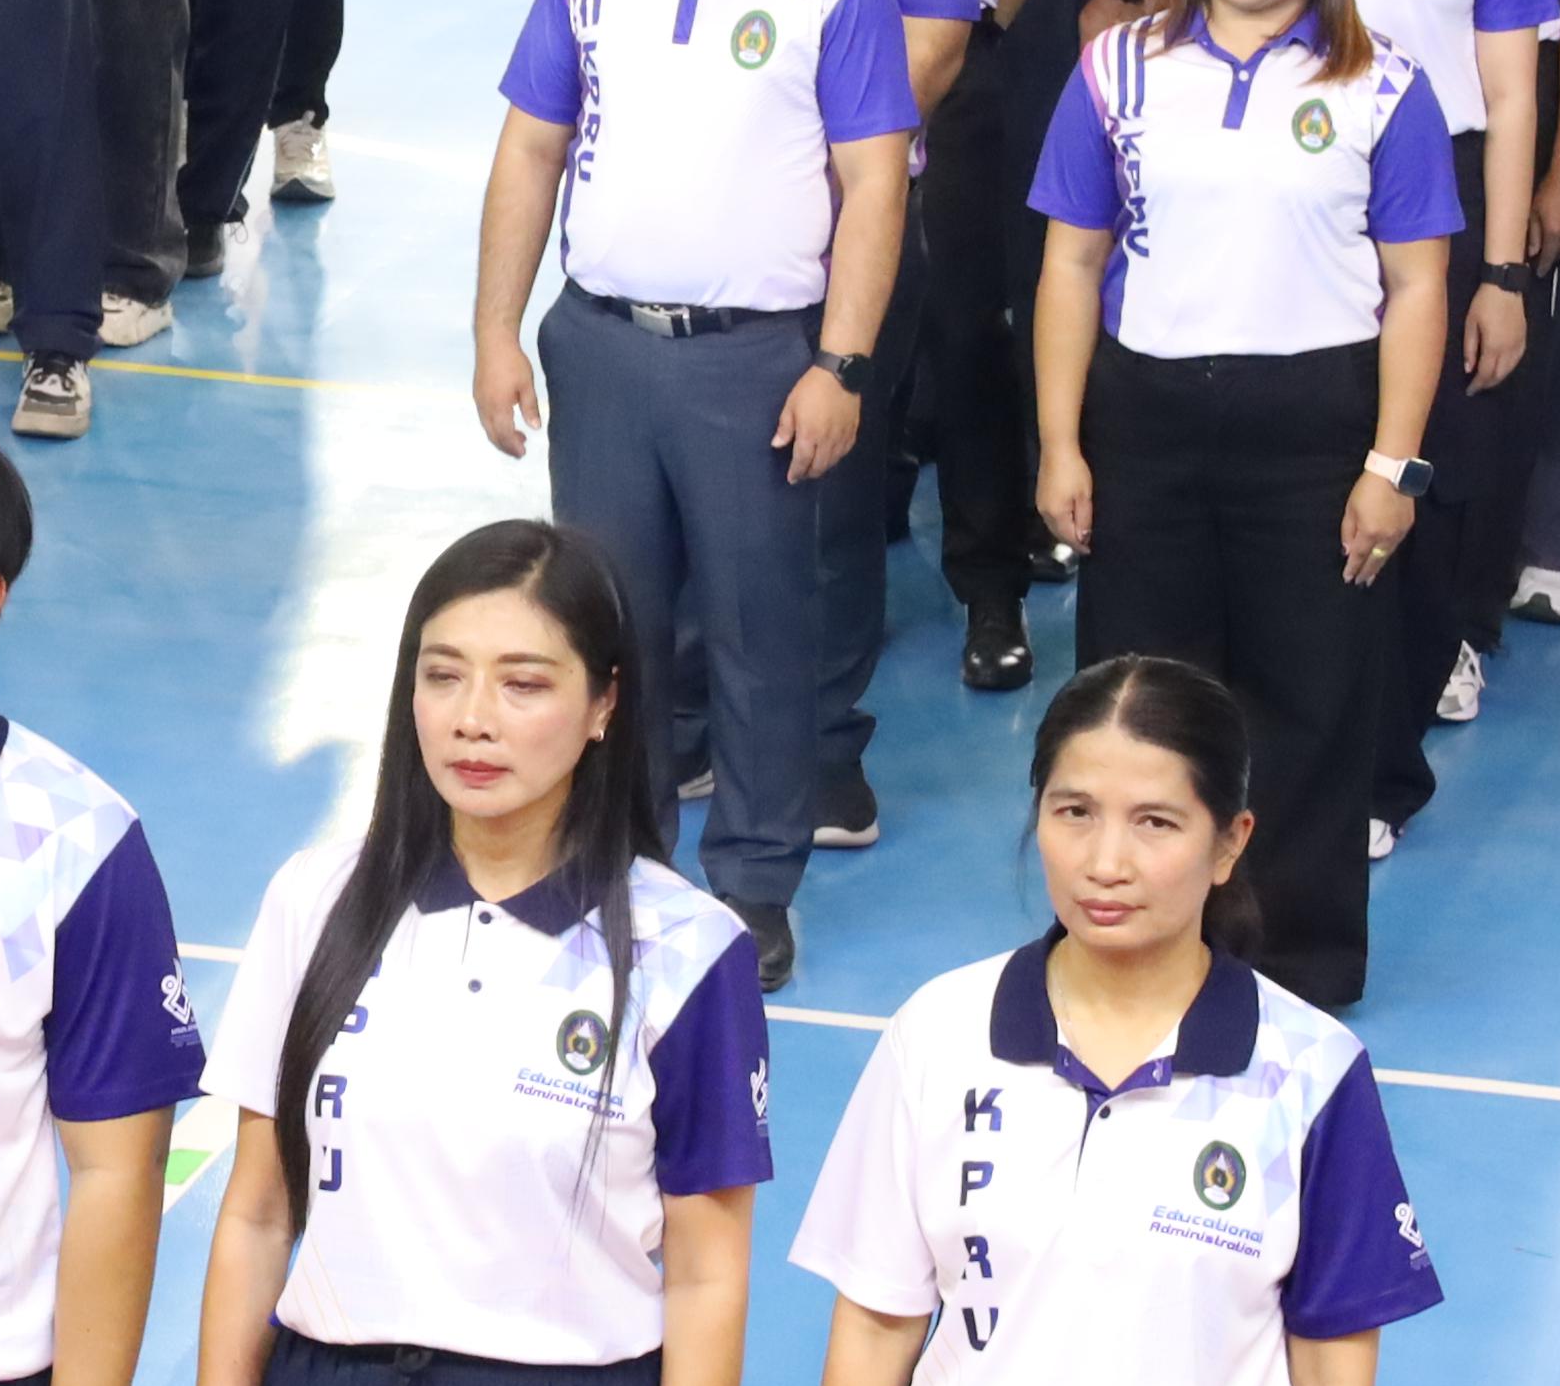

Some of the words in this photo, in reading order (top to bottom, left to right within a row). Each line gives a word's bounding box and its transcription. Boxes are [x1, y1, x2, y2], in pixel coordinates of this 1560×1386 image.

[959, 1086, 1004, 1352] KPRU
[1151, 1204, 1264, 1243] Educational
[1149, 1221, 1261, 1259] Administration
